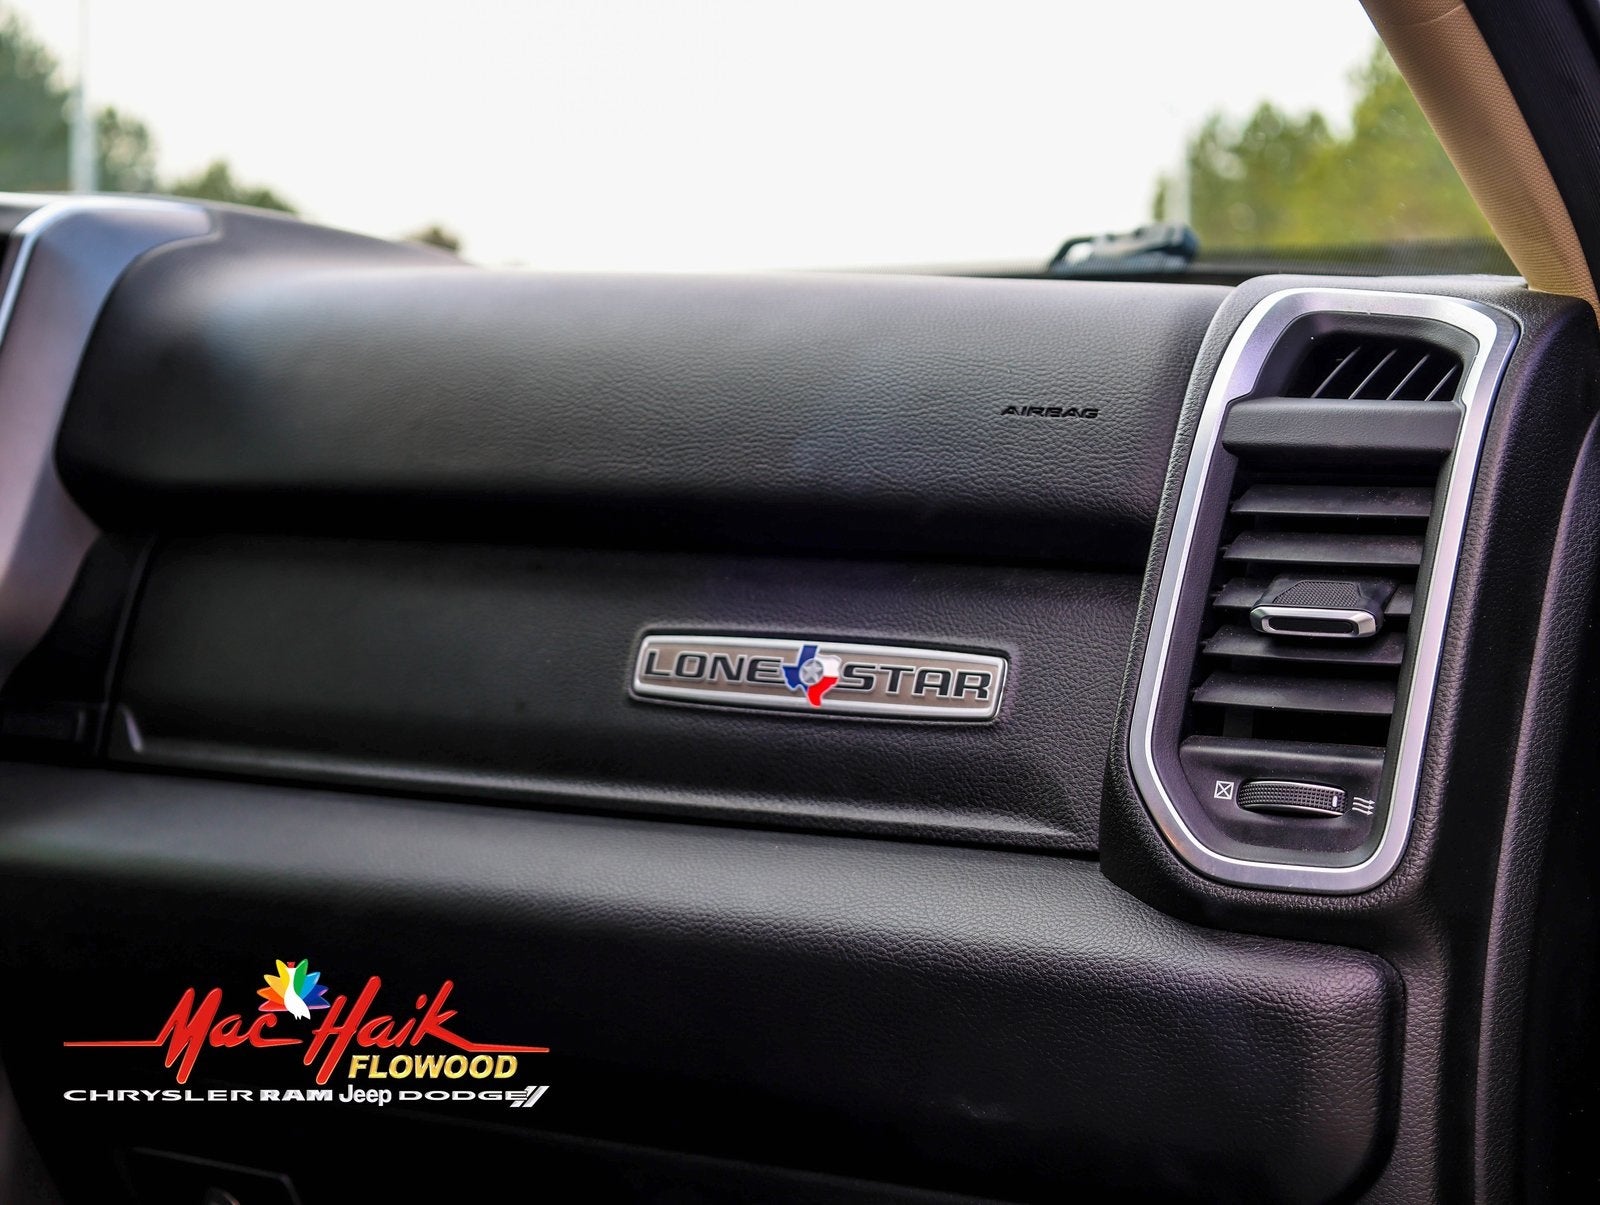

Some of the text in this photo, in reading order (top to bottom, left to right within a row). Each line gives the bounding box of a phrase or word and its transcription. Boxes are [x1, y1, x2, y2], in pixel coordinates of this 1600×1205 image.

[1000, 405, 1099, 419] AIRBAG
[643, 650, 992, 700] LONE STAR
